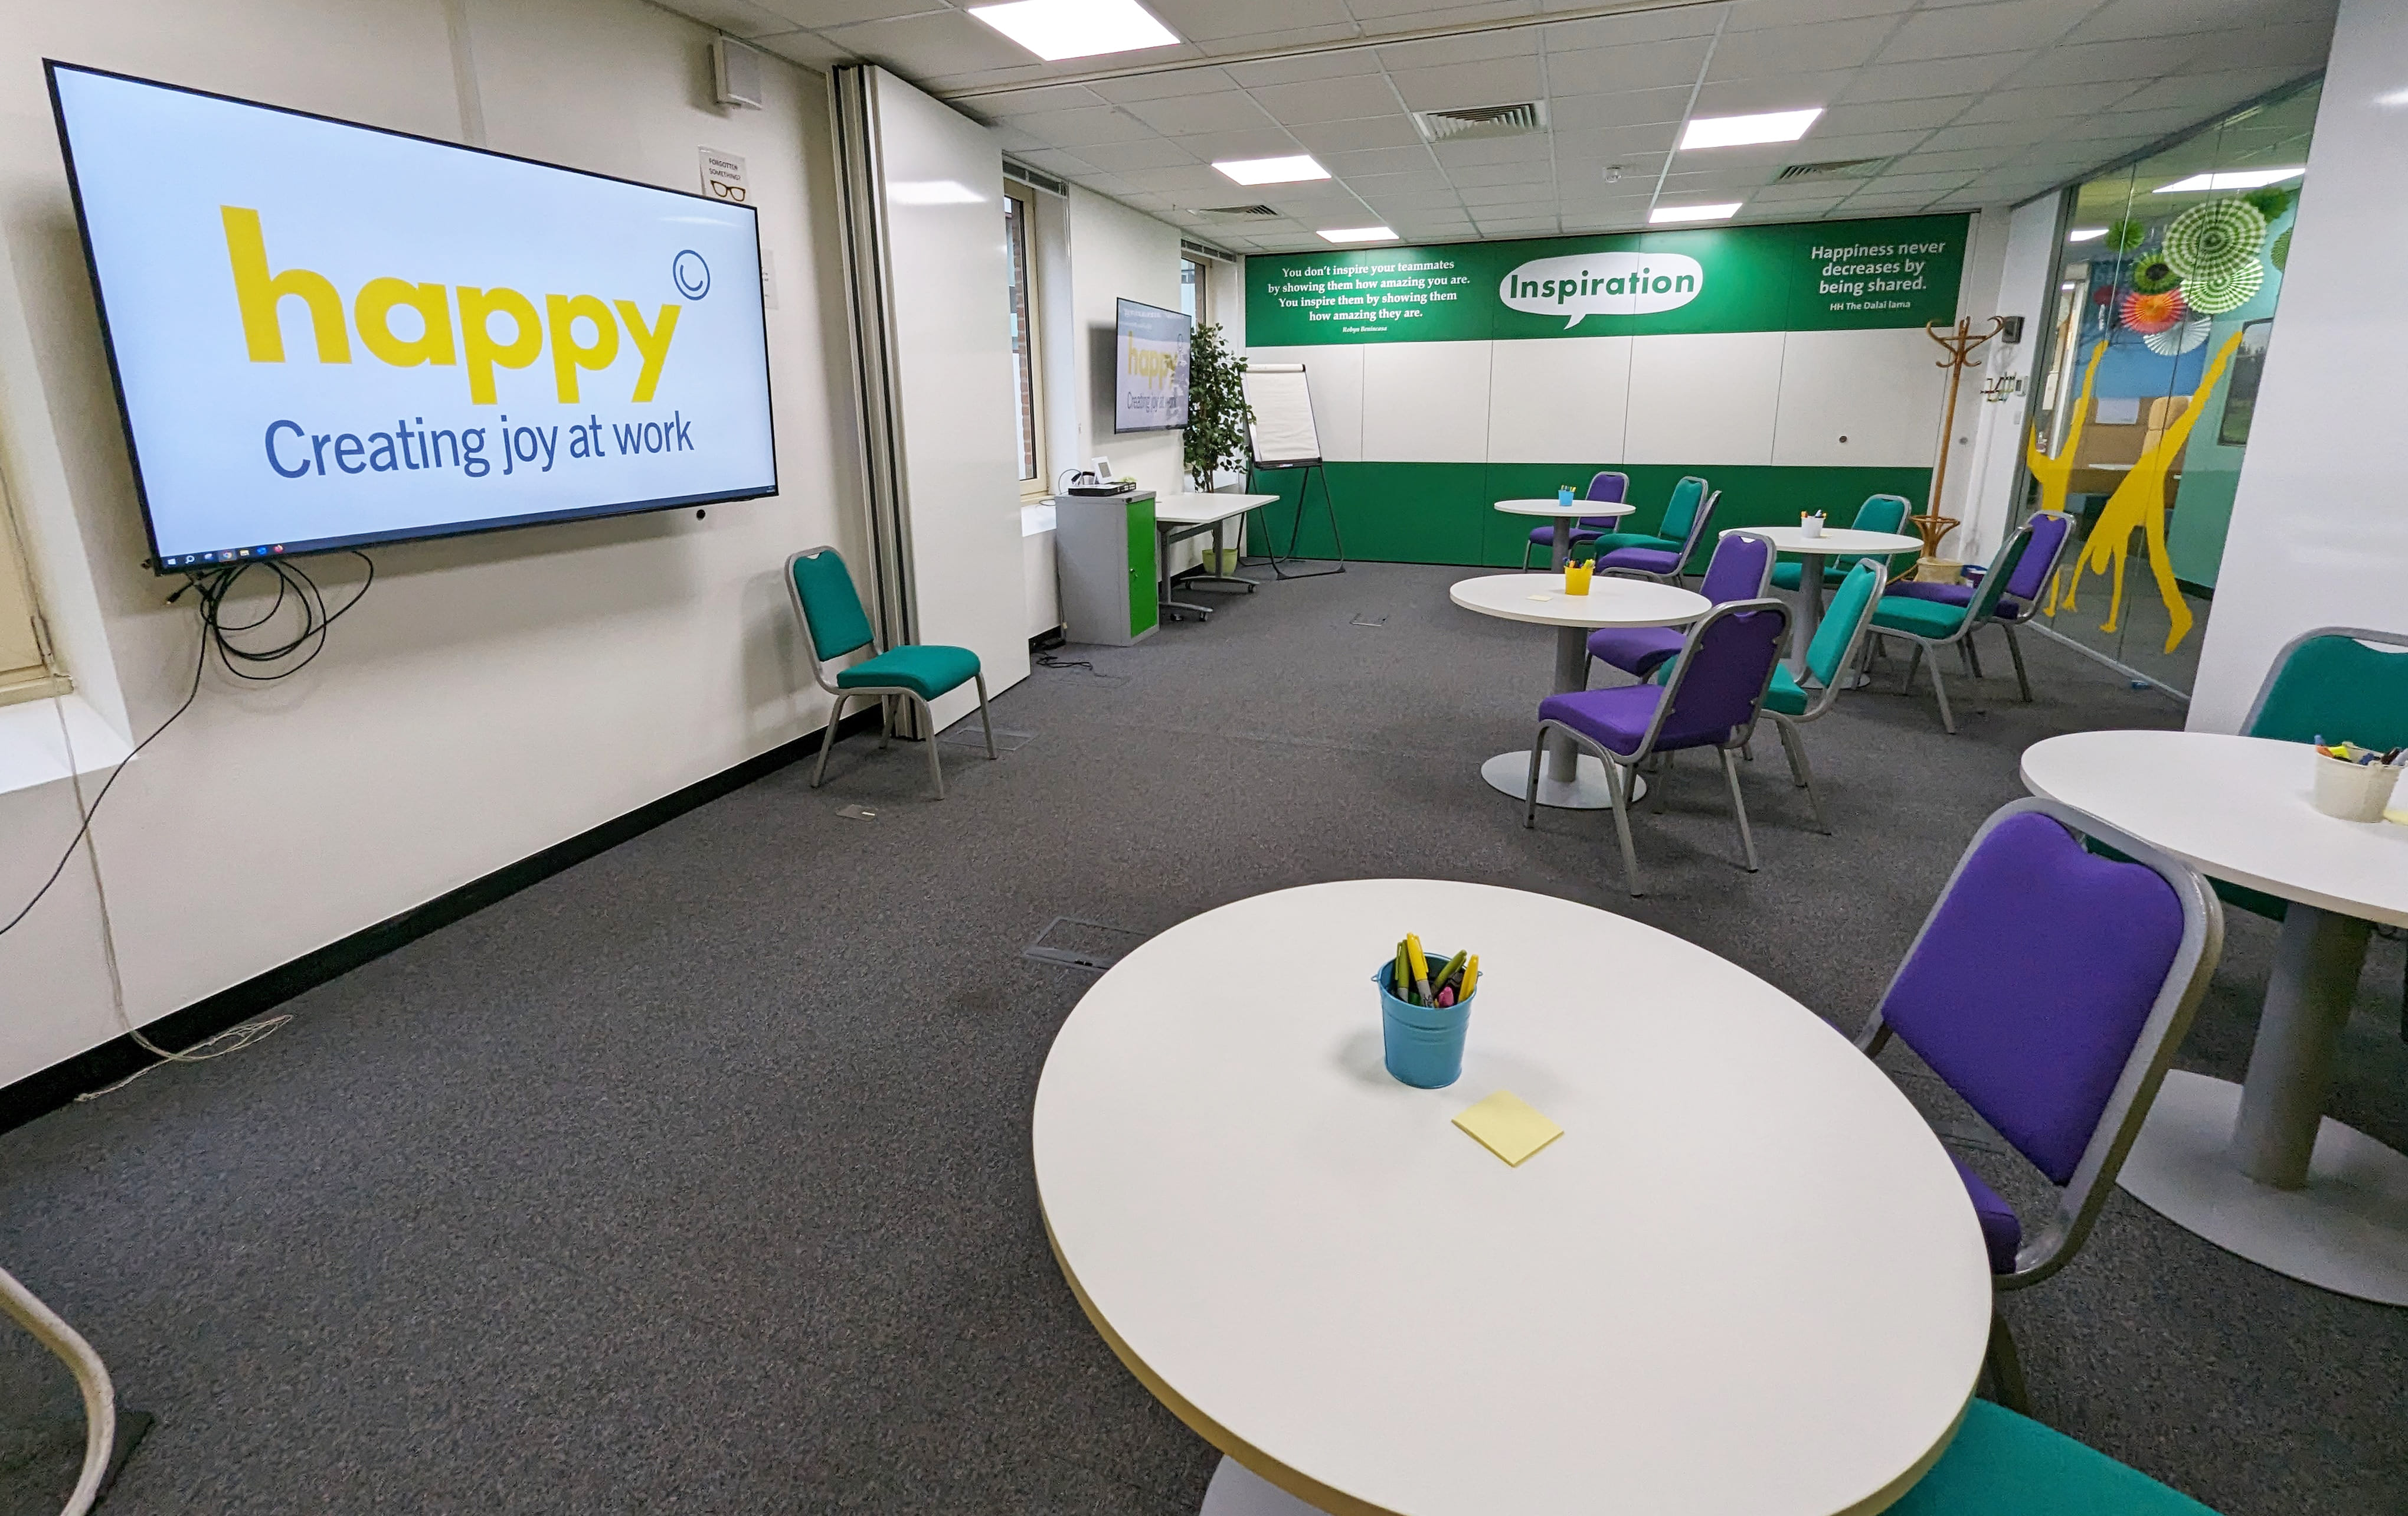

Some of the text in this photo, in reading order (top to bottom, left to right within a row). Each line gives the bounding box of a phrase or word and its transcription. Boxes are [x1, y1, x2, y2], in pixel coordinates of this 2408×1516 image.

[709, 158, 738, 171] FORGOTTEN
[1811, 242, 1946, 262] Happiness never
[1282, 260, 1455, 277] You don't inspire your teammates
[1823, 259, 1925, 276] decreases by
[1268, 276, 1470, 295] by showing them how amazing you are.
[1510, 267, 1694, 305] Inspiration
[1819, 276, 1926, 296] being shared.
[221, 205, 681, 404] happy
[1278, 291, 1457, 308] You inspire them by showing them
[1864, 301, 1886, 310] Dalai
[1888, 300, 1910, 309] lama
[1309, 308, 1423, 322] how amazing they are.
[265, 410, 695, 479] Creating joy at work
